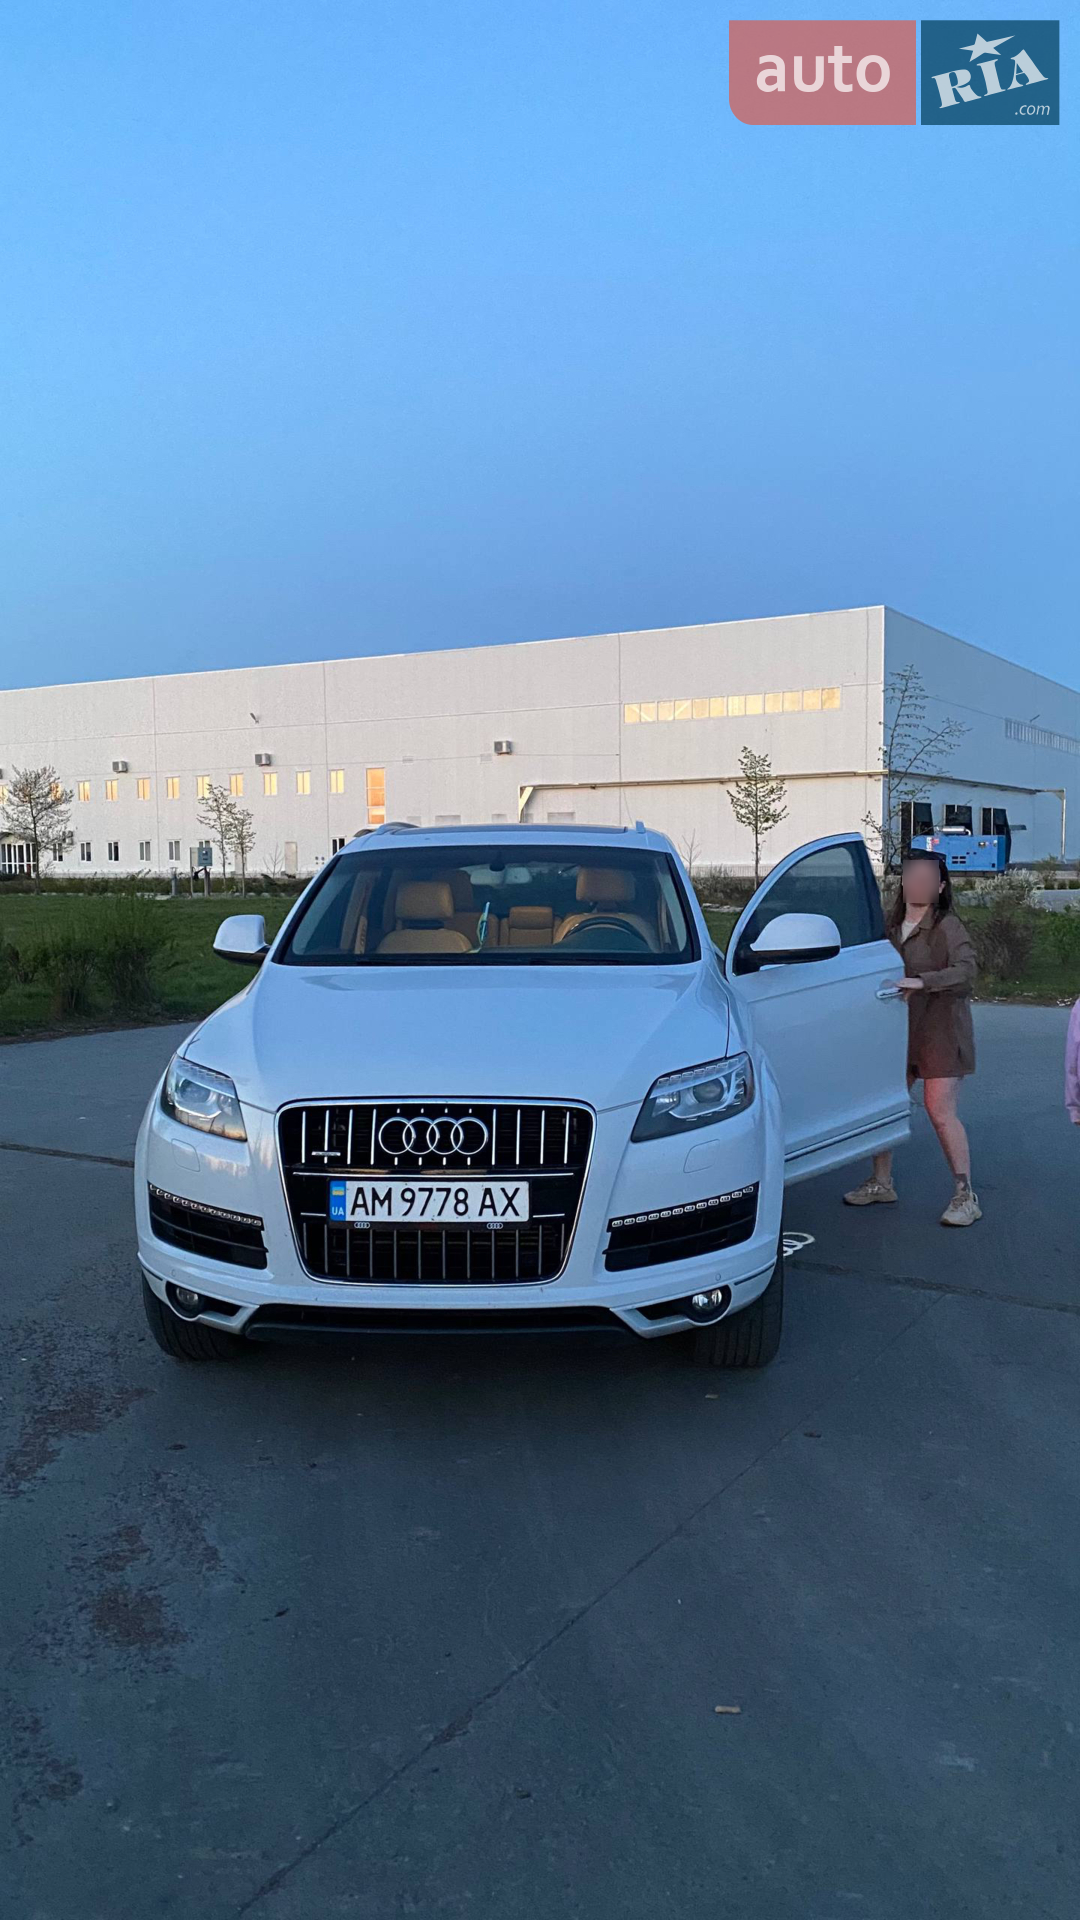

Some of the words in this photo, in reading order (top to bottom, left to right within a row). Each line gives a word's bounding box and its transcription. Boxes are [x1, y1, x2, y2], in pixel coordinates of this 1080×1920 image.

[350, 1187, 393, 1216] AM
[400, 1187, 469, 1216] 9778
[478, 1187, 520, 1216] AX
[331, 1207, 345, 1216] UA
